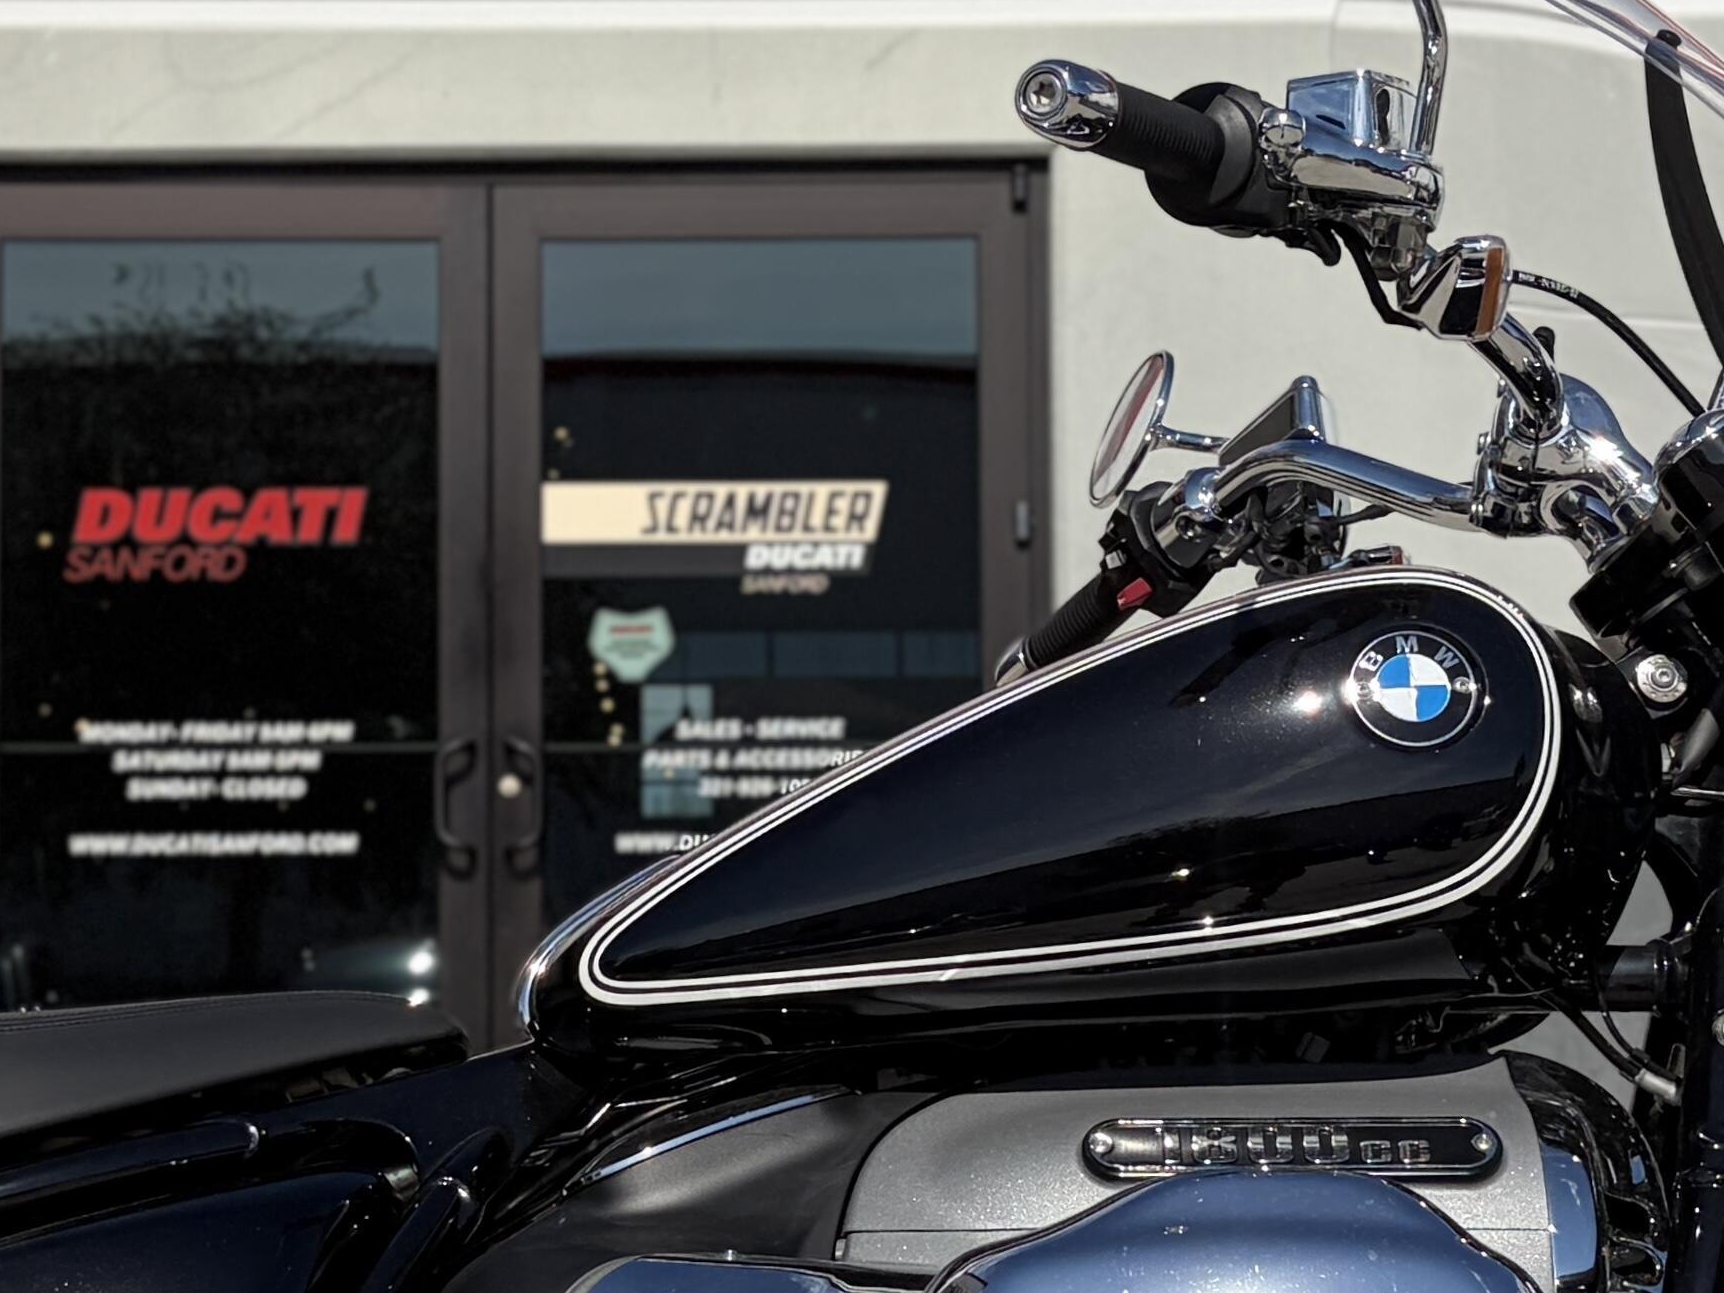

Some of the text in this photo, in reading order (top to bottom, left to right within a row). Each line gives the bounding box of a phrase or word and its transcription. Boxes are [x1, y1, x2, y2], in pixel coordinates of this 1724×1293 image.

[73, 486, 368, 545] DUCATI
[640, 490, 874, 536] SCRAMBLER
[63, 544, 247, 583] SANFORD
[743, 543, 866, 571] DUCATI
[1359, 635, 1460, 672] BMW
